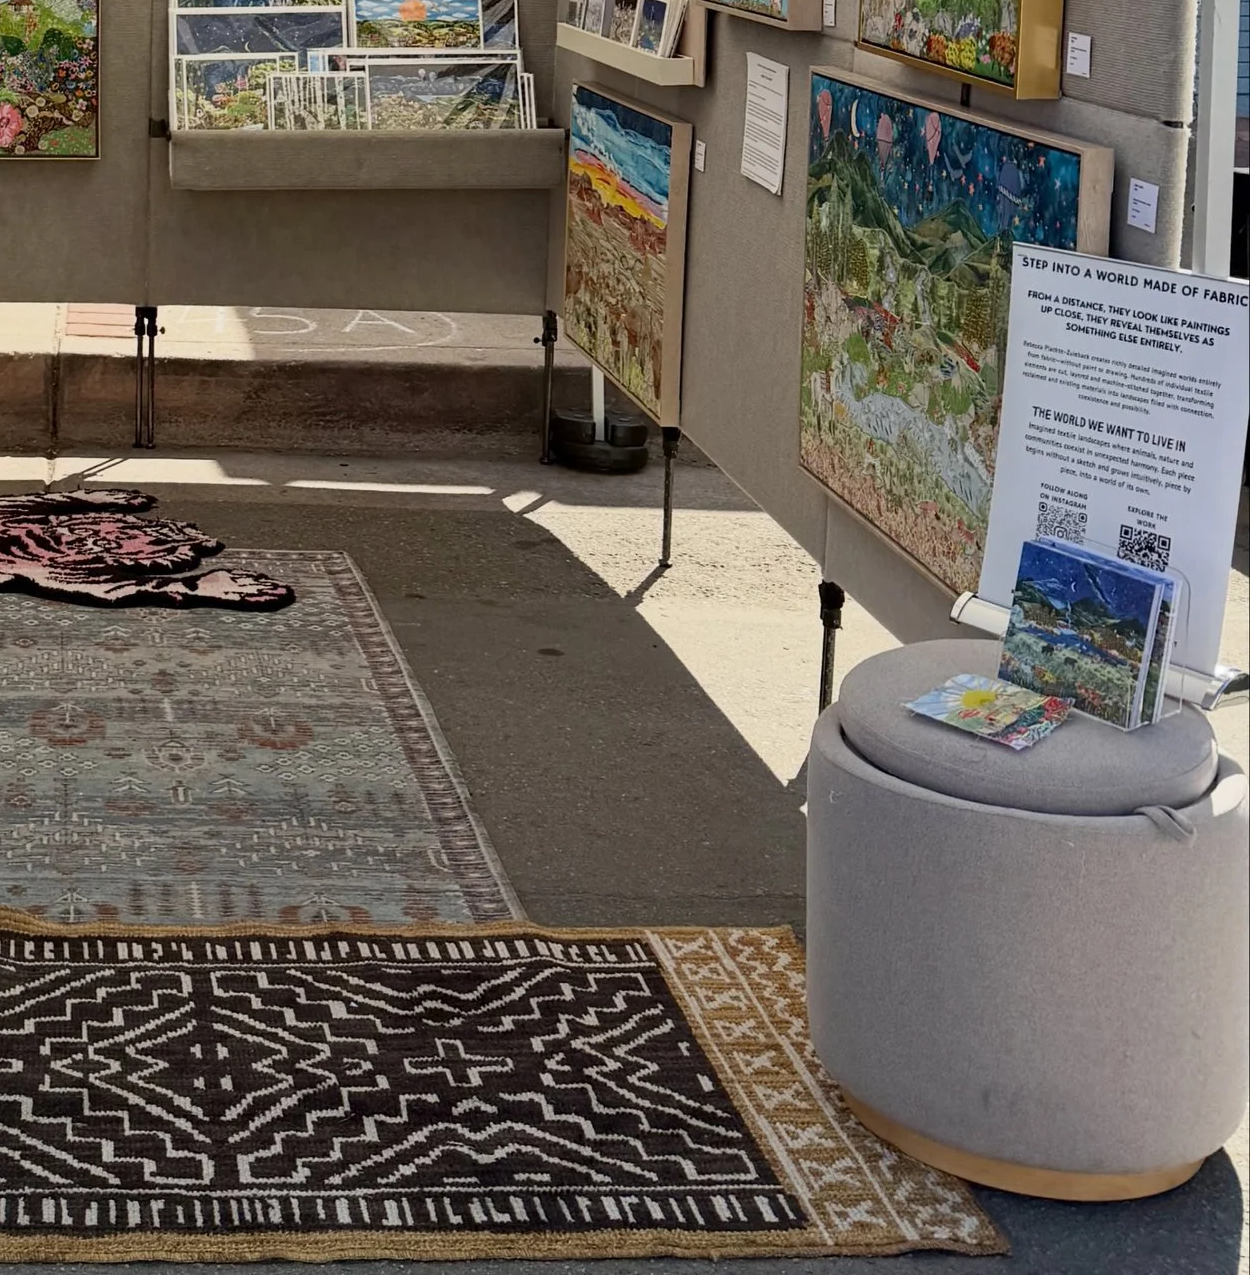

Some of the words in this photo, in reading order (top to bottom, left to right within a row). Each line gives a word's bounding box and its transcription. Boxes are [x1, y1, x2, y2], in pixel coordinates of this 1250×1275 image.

[1022, 256, 1048, 270] STEP
[1052, 262, 1080, 276] INTO
[1084, 268, 1092, 278] A
[1096, 270, 1138, 286] WORLD
[1144, 278, 1177, 294] MADE
[1182, 285, 1199, 298] OF
[1204, 289, 1248, 307] FABRIC
[1028, 290, 1052, 302] FROM
[1062, 296, 1106, 313] DISTANCE,
[1108, 305, 1131, 316] THEY
[1132, 310, 1158, 322] LOOK
[1160, 315, 1179, 326] LIKE
[1181, 319, 1230, 336] PAINTINGS
[1041, 305, 1052, 313] UP
[1054, 308, 1084, 321] CLOSE,
[1086, 314, 1108, 325] THEY
[1110, 318, 1142, 332] REVEAL
[1145, 325, 1200, 343] THEMSELVES
[1202, 338, 1214, 346] AS
[1066, 322, 1116, 339] SOMETHING
[1119, 333, 1138, 344] ELSE
[1140, 337, 1182, 353] ENTIRELY.
[1022, 371, 1047, 380] reclaimed
[1059, 380, 1080, 390] existing
[1082, 384, 1106, 394] materials
[1120, 392, 1149, 404] landscapes
[1151, 398, 1165, 407] filled
[1024, 362, 1047, 371] elements
[1070, 371, 1089, 380] layered
[1177, 394, 1214, 410] transforming
[1112, 360, 1127, 369] richly
[1128, 363, 1150, 372] detailed
[1151, 368, 1177, 378] imagined
[1178, 375, 1197, 383] worlds
[1198, 378, 1222, 389] entirely
[1130, 373, 1156, 384] Hundreds
[1165, 382, 1193, 392] individual
[1194, 388, 1214, 397] textile
[1078, 394, 1109, 405] coexistence
[1029, 422, 1056, 434] Imagined
[1057, 430, 1076, 440] textile
[1078, 434, 1110, 448] landscapes
[1112, 443, 1130, 453] where
[1158, 455, 1180, 465] nature
[1032, 406, 1052, 420] THE
[1054, 411, 1086, 428] WORLD
[1088, 419, 1104, 432] WE
[1106, 423, 1135, 440] WANT
[1136, 430, 1150, 443] TO
[1152, 434, 1173, 450] LIVE
[1175, 440, 1186, 452] IN
[1025, 434, 1062, 448] communities
[1064, 444, 1085, 454] coexist
[1094, 452, 1130, 465] unexpected
[1161, 466, 1176, 476] Each
[1178, 472, 1195, 482] piece
[1026, 445, 1044, 456] begins
[1046, 452, 1070, 462] without
[1076, 458, 1096, 468] sketch
[1110, 468, 1129, 477] grows
[1164, 481, 1181, 491] piece
[1183, 485, 1191, 494] by
[1041, 482, 1066, 494] FOLLOW
[1067, 490, 1088, 500] ALONG
[1079, 470, 1092, 480] into
[1099, 477, 1117, 486] world
[1052, 496, 1086, 510] INSTAGRAM
[1128, 506, 1154, 518] EXPLORE
[1156, 513, 1168, 522] THE
[1136, 518, 1156, 530] WORK
